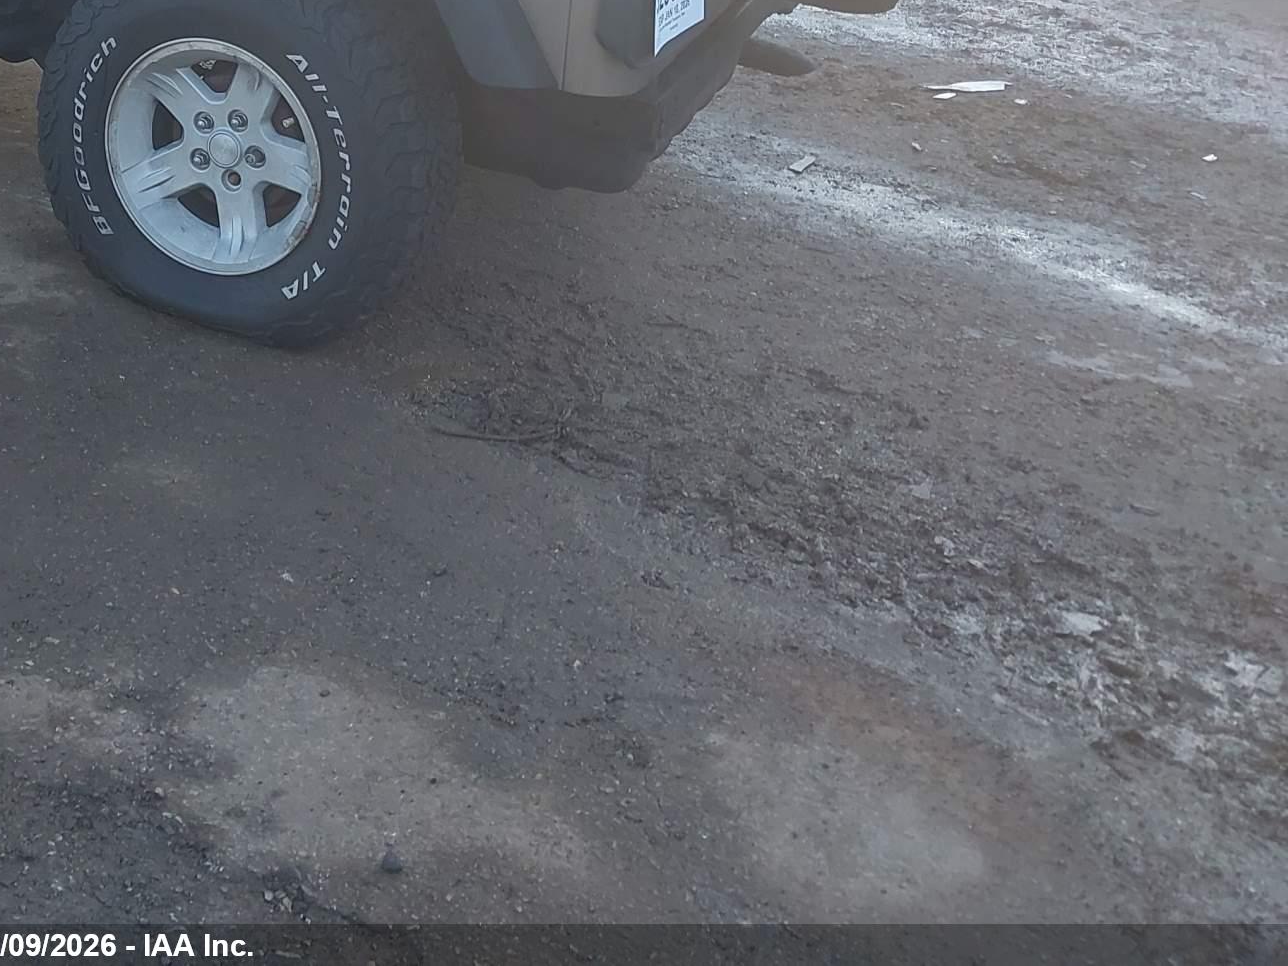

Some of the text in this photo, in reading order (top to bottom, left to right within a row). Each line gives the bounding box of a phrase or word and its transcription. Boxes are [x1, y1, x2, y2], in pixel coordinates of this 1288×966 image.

[71, 35, 117, 236] BFGoodrich
[281, 52, 353, 301] All-Terrain T/A
